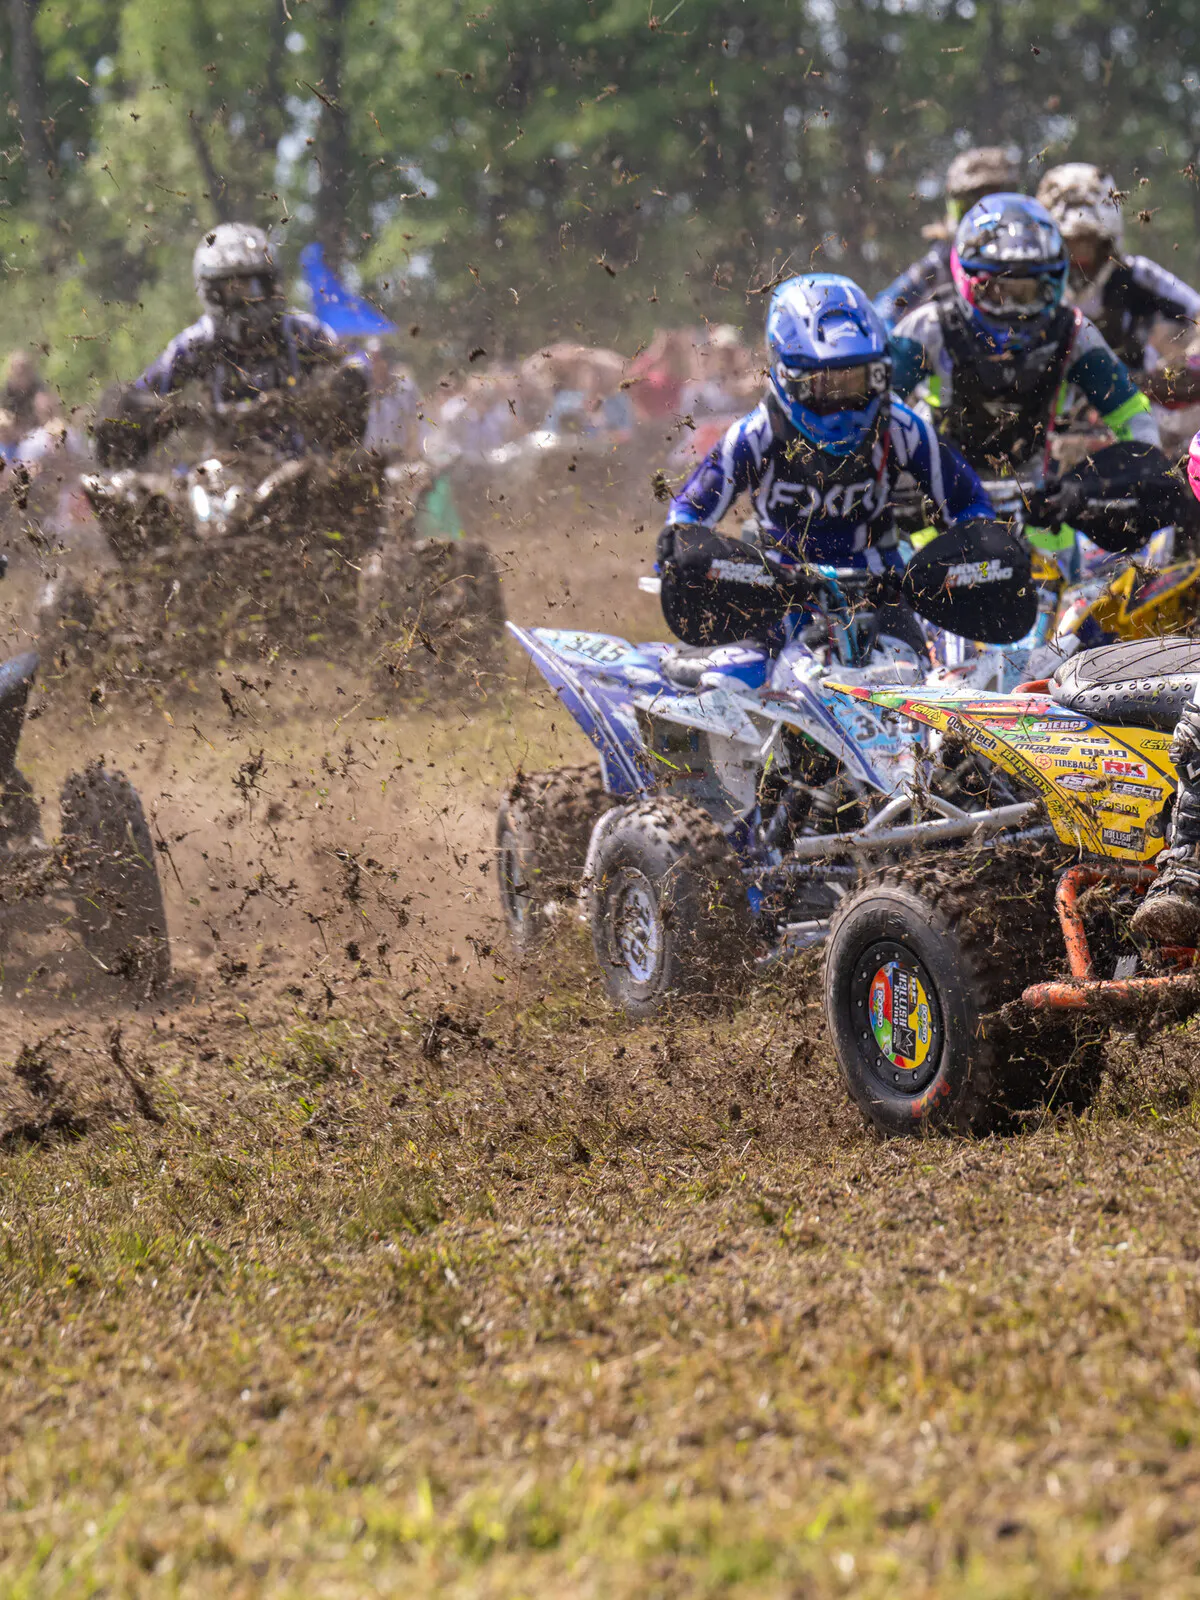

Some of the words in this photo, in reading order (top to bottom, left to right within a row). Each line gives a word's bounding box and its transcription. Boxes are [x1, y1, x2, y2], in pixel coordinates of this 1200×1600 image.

[768, 479, 876, 516] FXR
[947, 715, 997, 750] QuadTech
[1032, 720, 1087, 732] PIERCE
[1014, 743, 1072, 752] MOOSE
[1060, 736, 1110, 744] AXIS
[1001, 749, 1052, 794] HINSON
[1054, 759, 1098, 771] TIREBALLS
[1104, 761, 1145, 776] RK
[1090, 798, 1140, 814] RECISION
